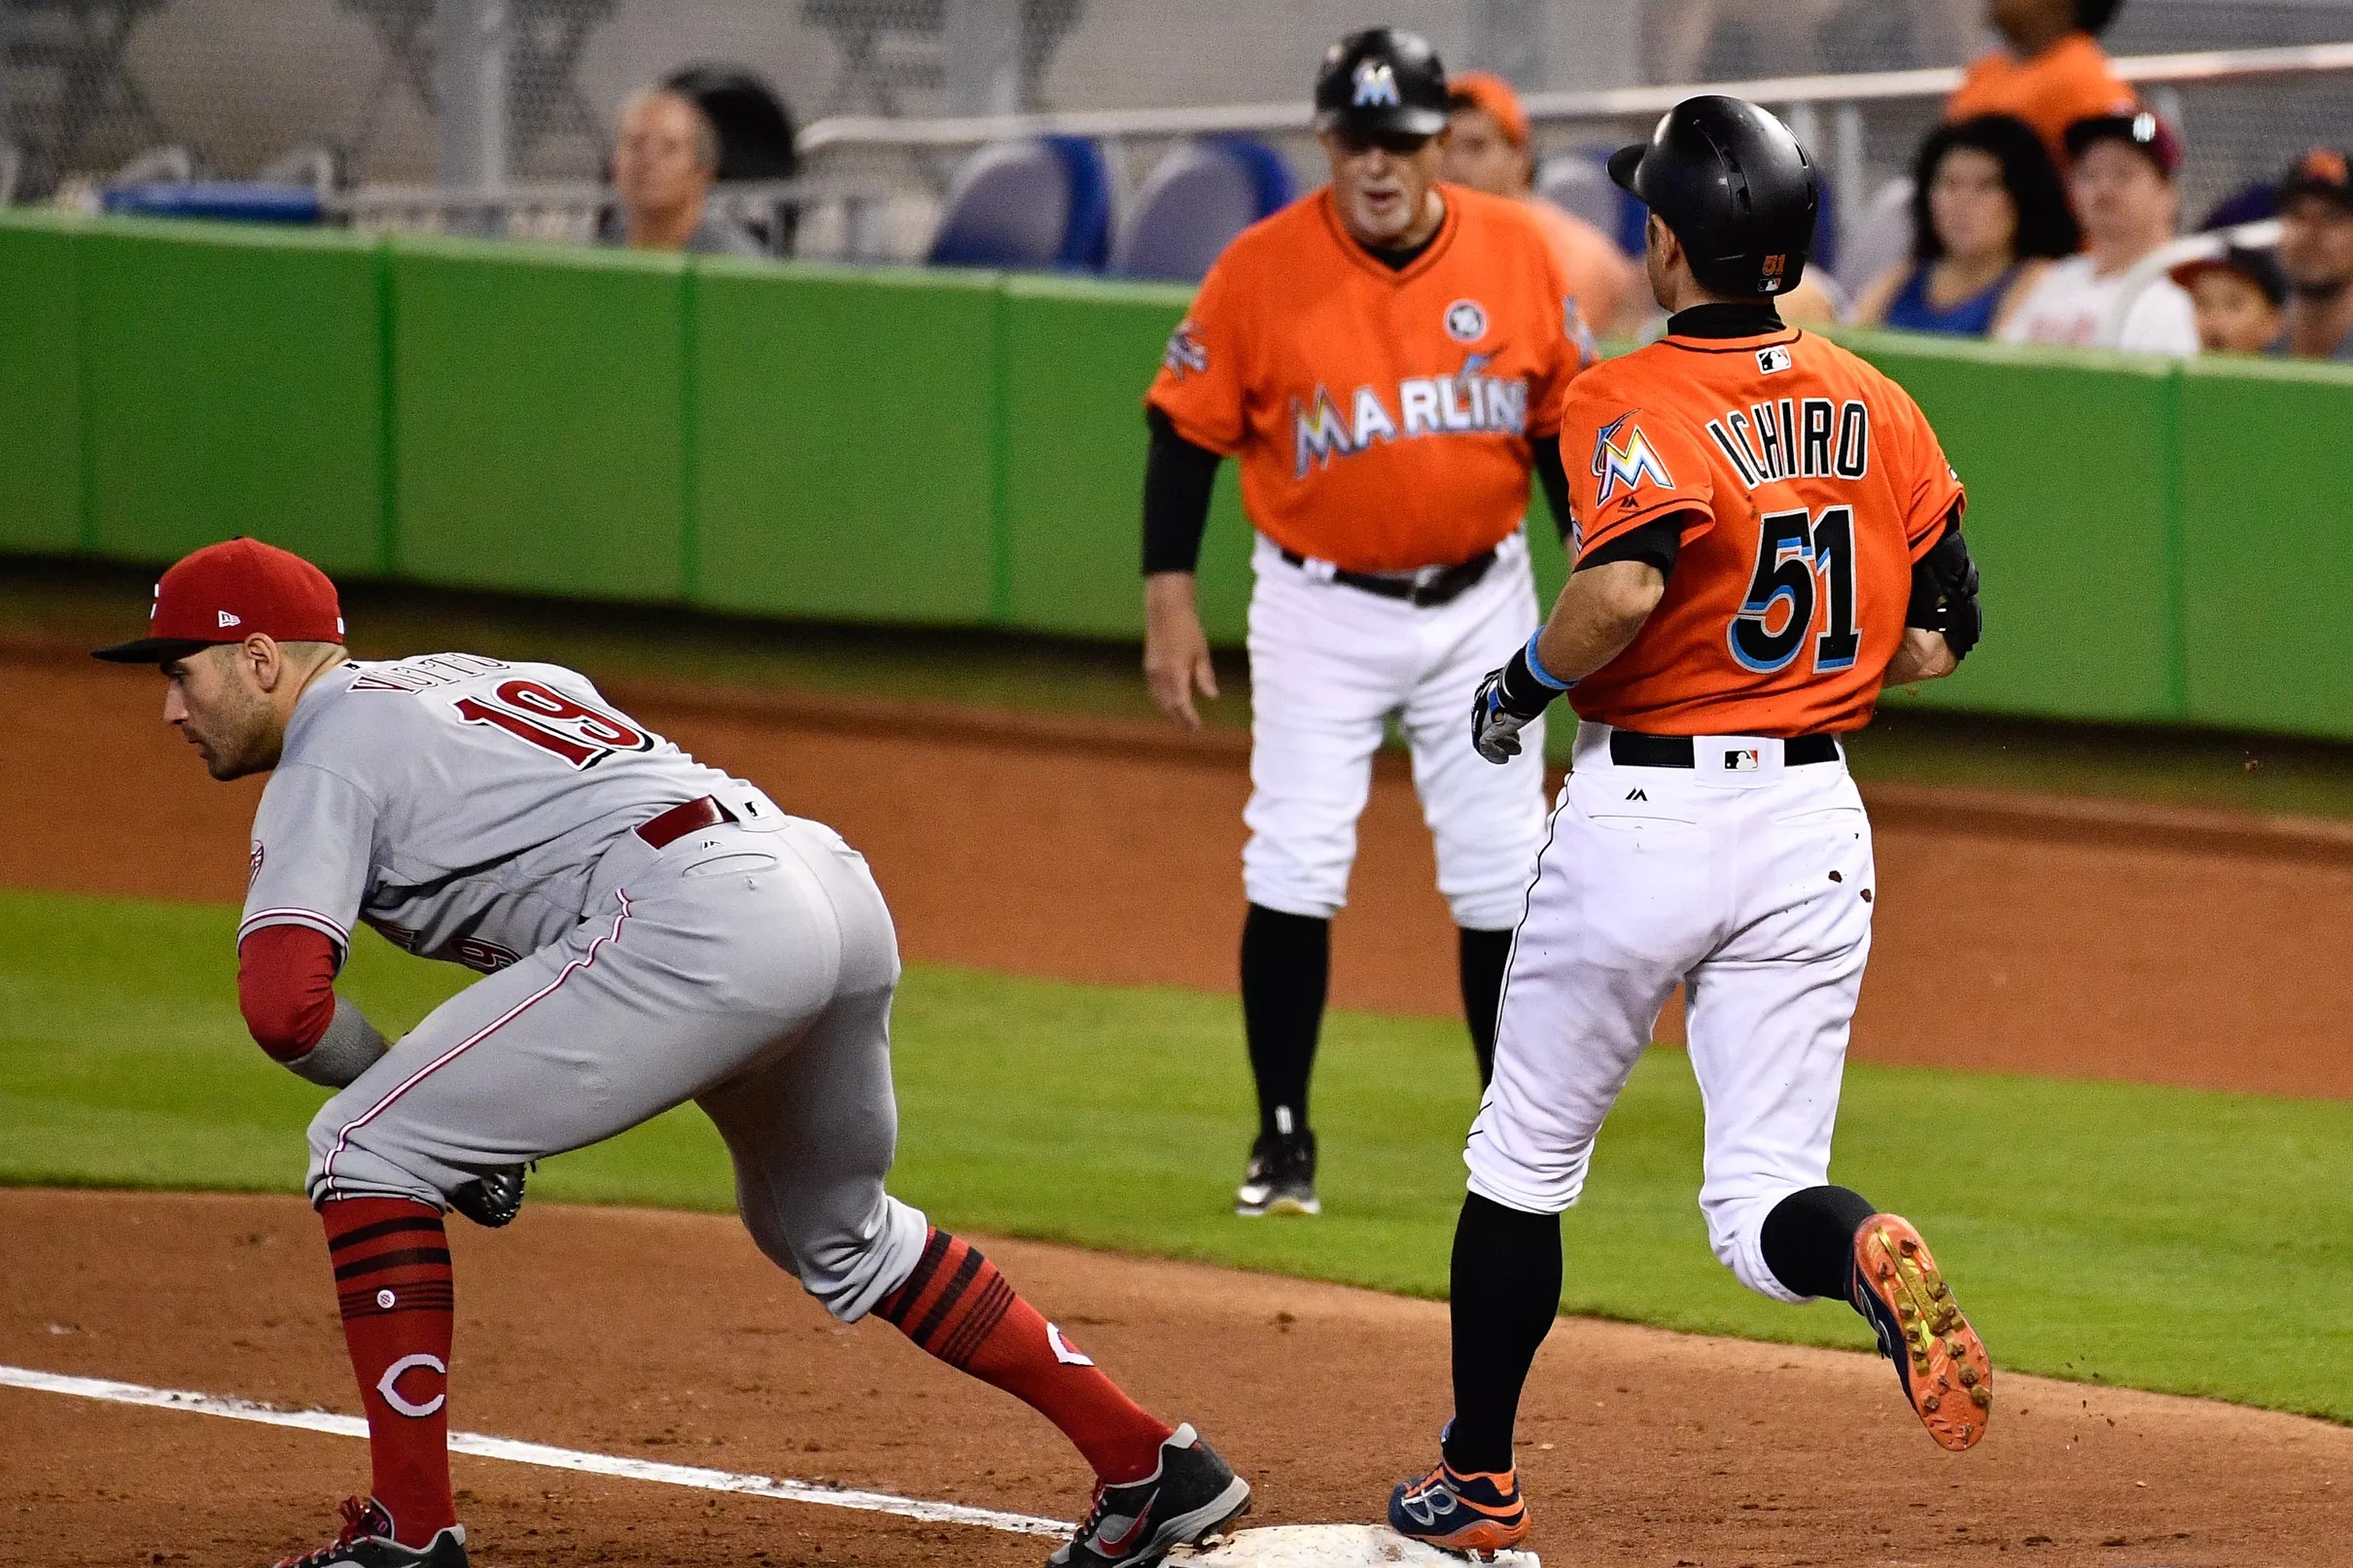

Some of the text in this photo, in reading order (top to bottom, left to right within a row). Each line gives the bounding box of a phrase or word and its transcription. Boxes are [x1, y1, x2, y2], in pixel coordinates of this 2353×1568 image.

[1762, 254, 1786, 276] 51
[1593, 420, 1677, 510] M
[1704, 397, 1870, 491] ICHIRO
[1727, 505, 1864, 674] 51
[446, 678, 655, 773] 19
[376, 1353, 446, 1418] C
